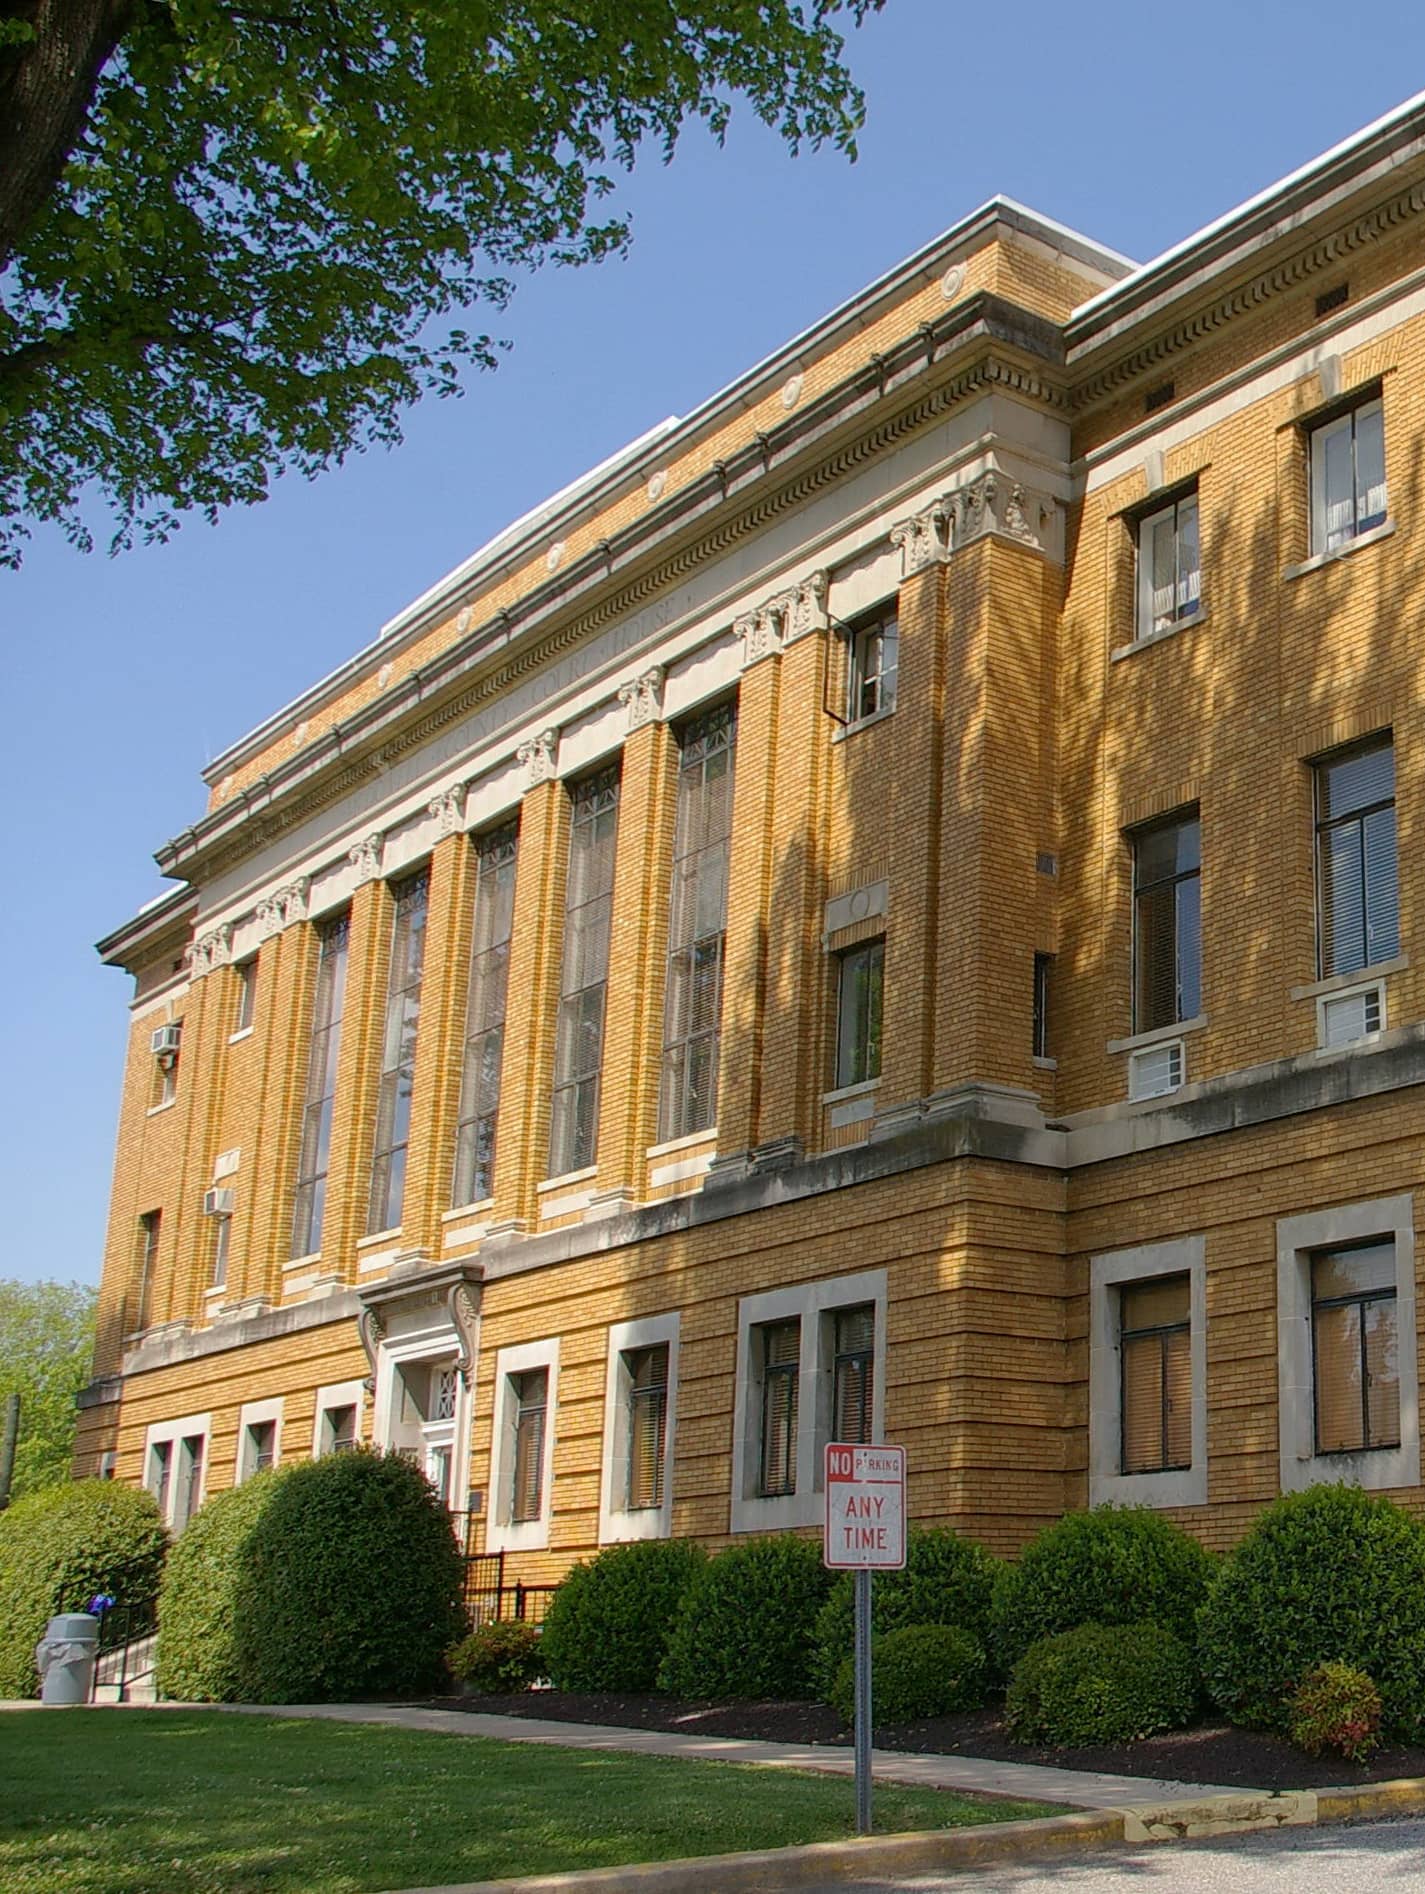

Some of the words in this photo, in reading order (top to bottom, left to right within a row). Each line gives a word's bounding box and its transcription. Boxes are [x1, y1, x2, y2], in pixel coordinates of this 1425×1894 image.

[830, 1452, 851, 1475] NO
[846, 1495, 884, 1519] ANY
[844, 1527, 887, 1549] TIME
